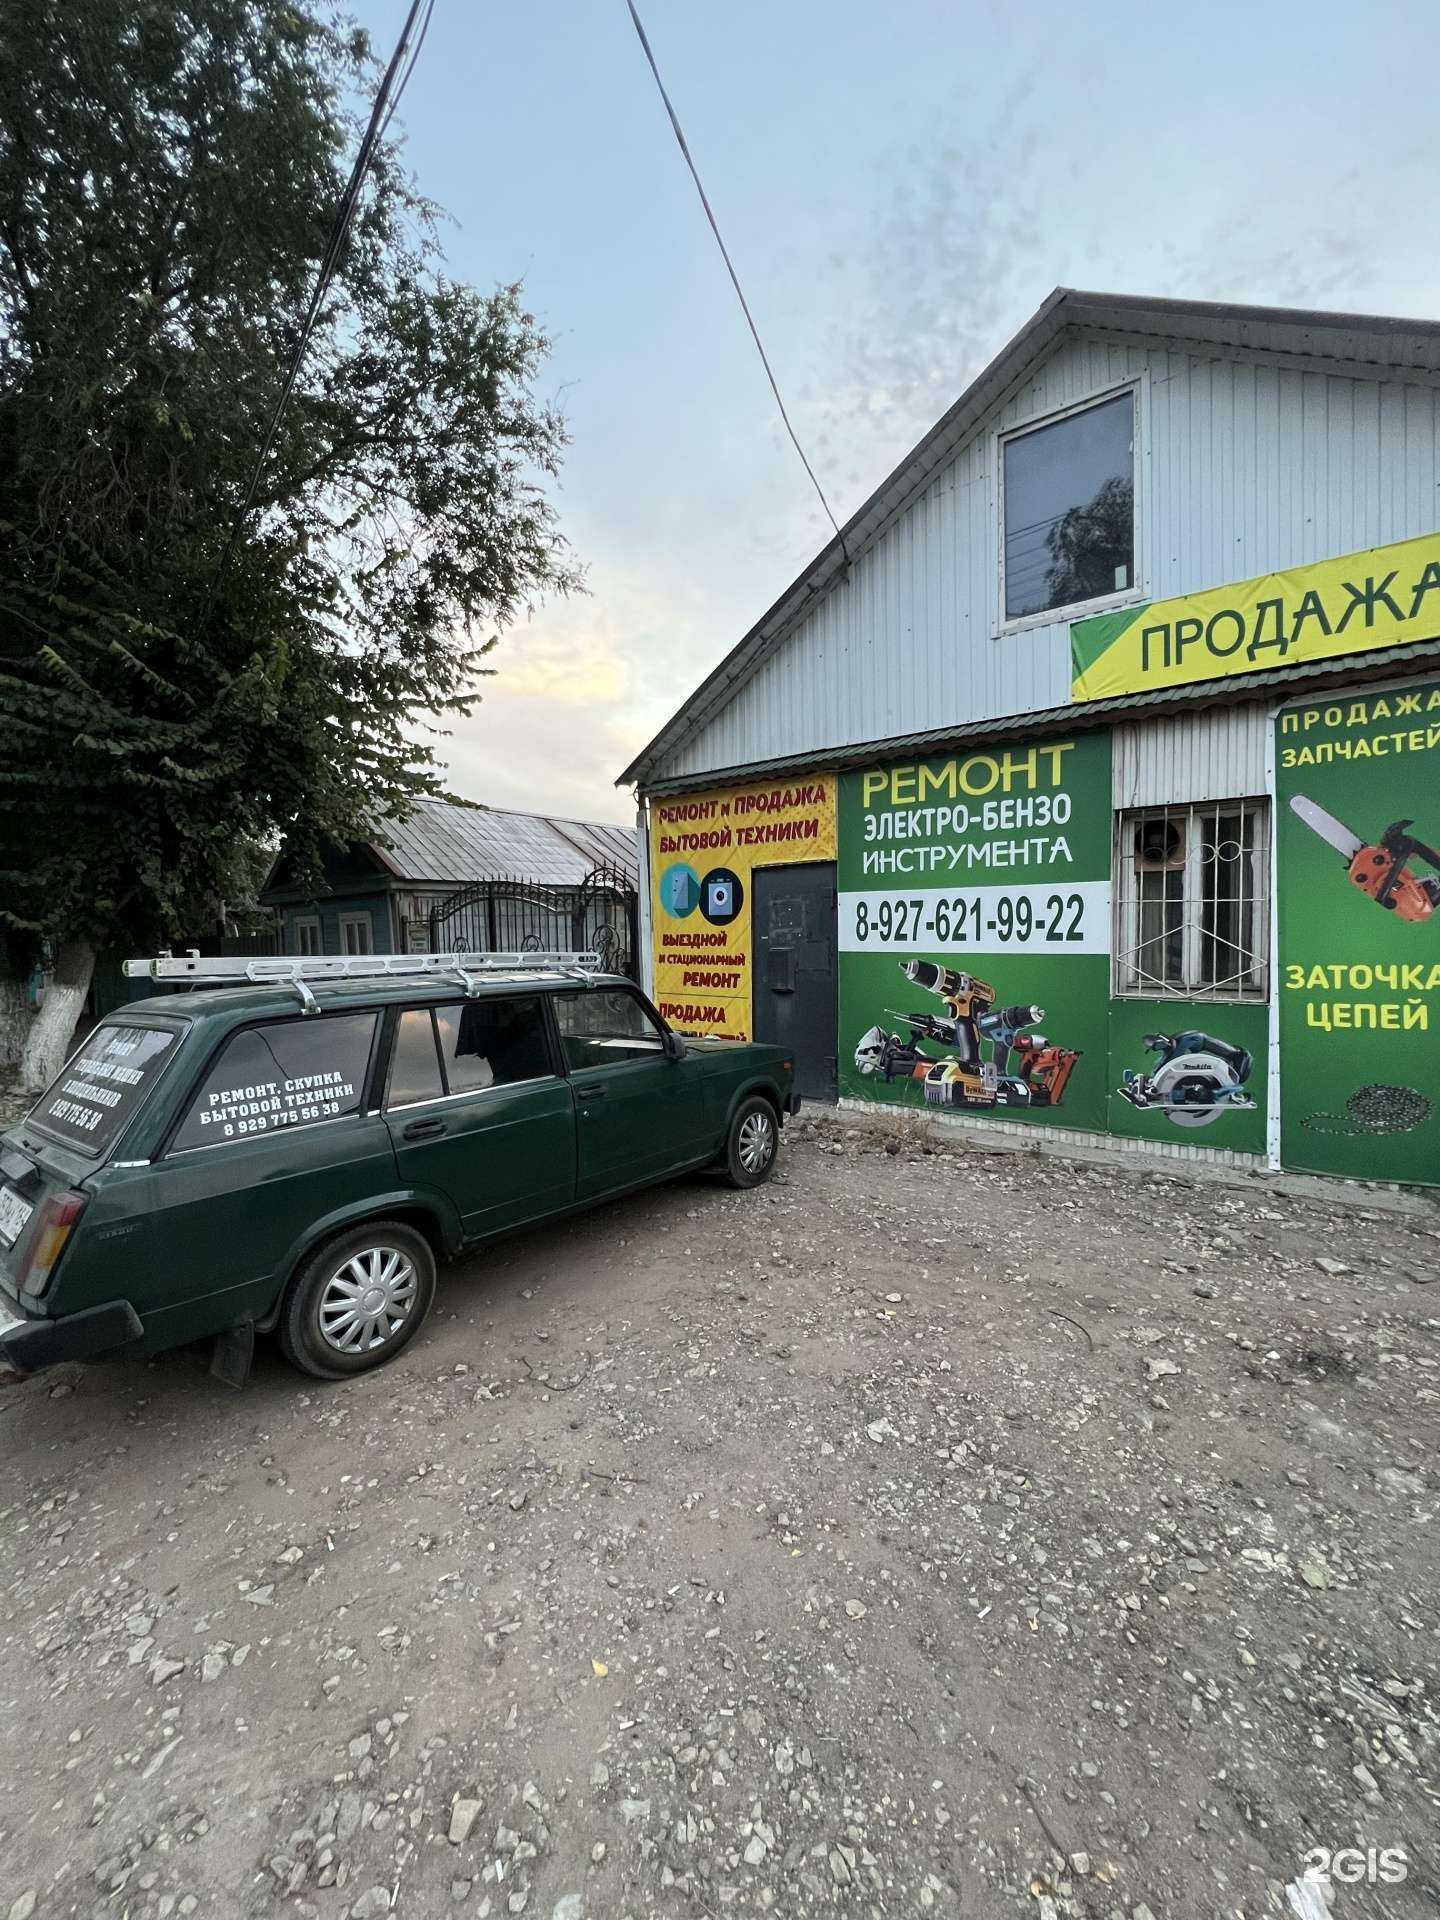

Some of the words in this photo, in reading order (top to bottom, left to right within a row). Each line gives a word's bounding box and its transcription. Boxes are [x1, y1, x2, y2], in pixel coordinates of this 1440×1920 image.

[1141, 561, 1440, 672] ПРОДАЖА
[1281, 690, 1440, 734] ПРОДАЖА
[1281, 722, 1440, 769] ЗАПЧАСТЕЙ
[863, 742, 1075, 808] РЕМОНТ
[659, 801, 718, 825] РЕМОНТ
[734, 784, 826, 815] ПРОДАЖА
[864, 793, 1072, 842] ЭЛЕКТРО-БЕНЗО
[659, 825, 732, 853] БЫТОВОЙ
[736, 818, 819, 846] ТЕХНИКИ
[863, 836, 1074, 875] ИНСТРУМЕНТА
[855, 893, 1084, 942] 8-927-621-99-22
[662, 930, 728, 949] ВЫЕЗДНОЙ
[658, 953, 666, 964] И
[667, 952, 746, 967] СТАЦИОНАРНЫЙ
[1286, 964, 1440, 990] ЗАТОЧКА
[683, 971, 741, 989] РЕМОНТ
[659, 1003, 726, 1024] ПРОДАЖА
[1307, 998, 1429, 1032] ЦЕПЕЙ
[284, 1071, 343, 1092] СКУПКА
[200, 1096, 282, 1125] БЫТОВОЙ
[284, 1083, 354, 1107] ТЕХНИКИ
[224, 1123, 234, 1136] 8
[238, 1117, 267, 1133] 929
[271, 1110, 299, 1126] 775
[302, 1106, 319, 1120] 56
[322, 1101, 340, 1116] 38
